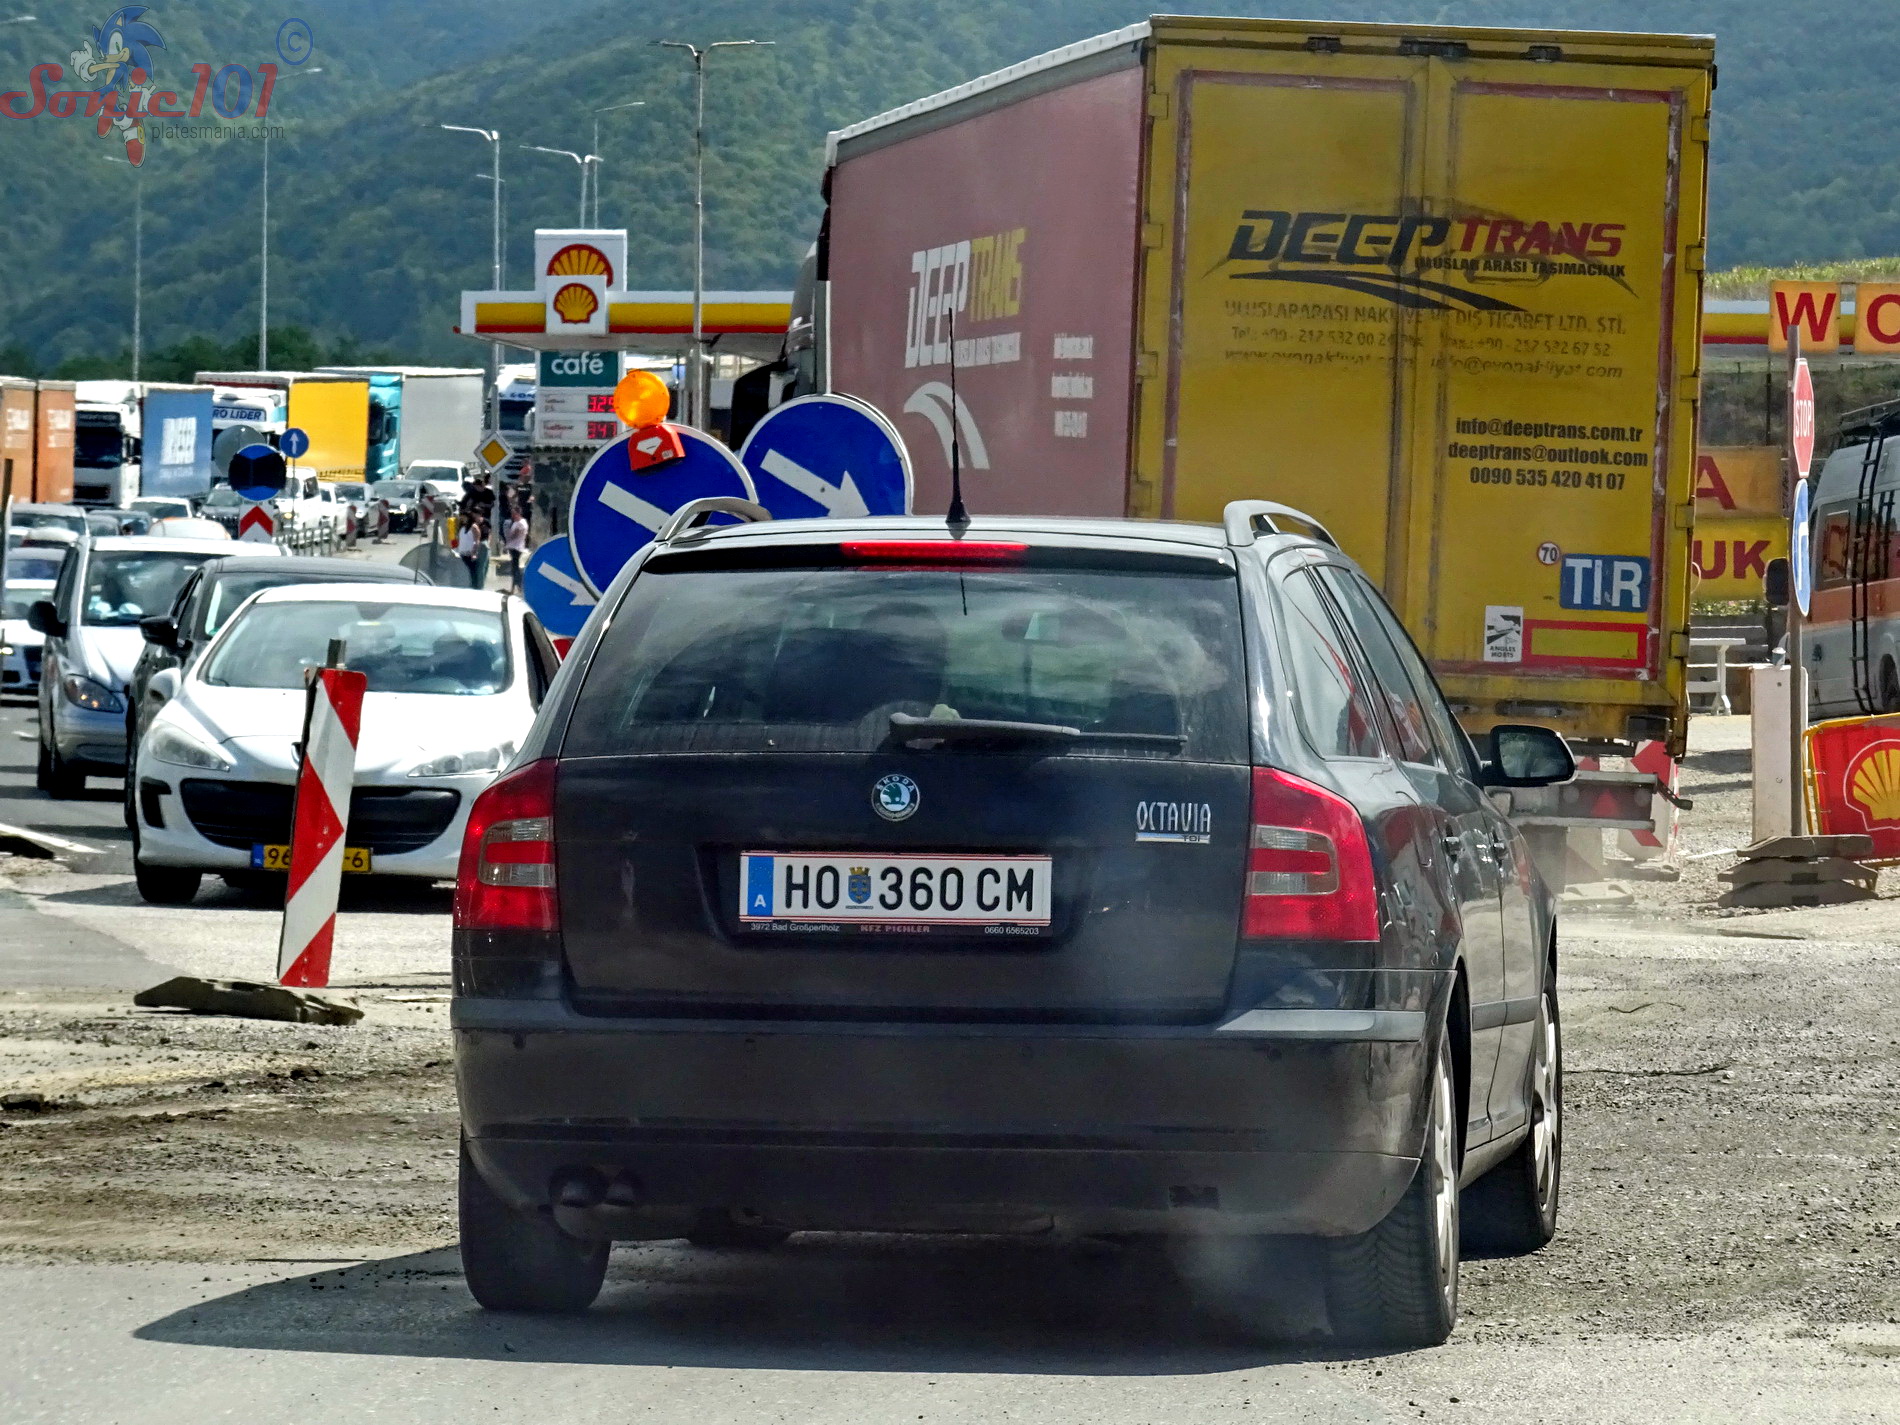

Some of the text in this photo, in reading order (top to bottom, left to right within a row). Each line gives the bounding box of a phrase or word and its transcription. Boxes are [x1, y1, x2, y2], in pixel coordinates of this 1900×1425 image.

[1483, 258, 1528, 273] ARASI
[551, 351, 604, 375] café
[230, 410, 262, 420] LIDER
[1795, 400, 1812, 437] STOP
[1456, 417, 1643, 442] info@deeptrans.com.tr
[1448, 442, 1648, 467] deeptrans@outlook.com
[1470, 467, 1625, 490] 0090 535 420 41 07
[1541, 547, 1558, 562] 70
[1565, 558, 1643, 608] TIR
[1136, 801, 1211, 833] OCTAVIA
[754, 864, 1034, 912] A HO 360 CM
[751, 923, 840, 932] 3972 Bad Großpertholz
[984, 926, 1039, 935] 0660 6565203
